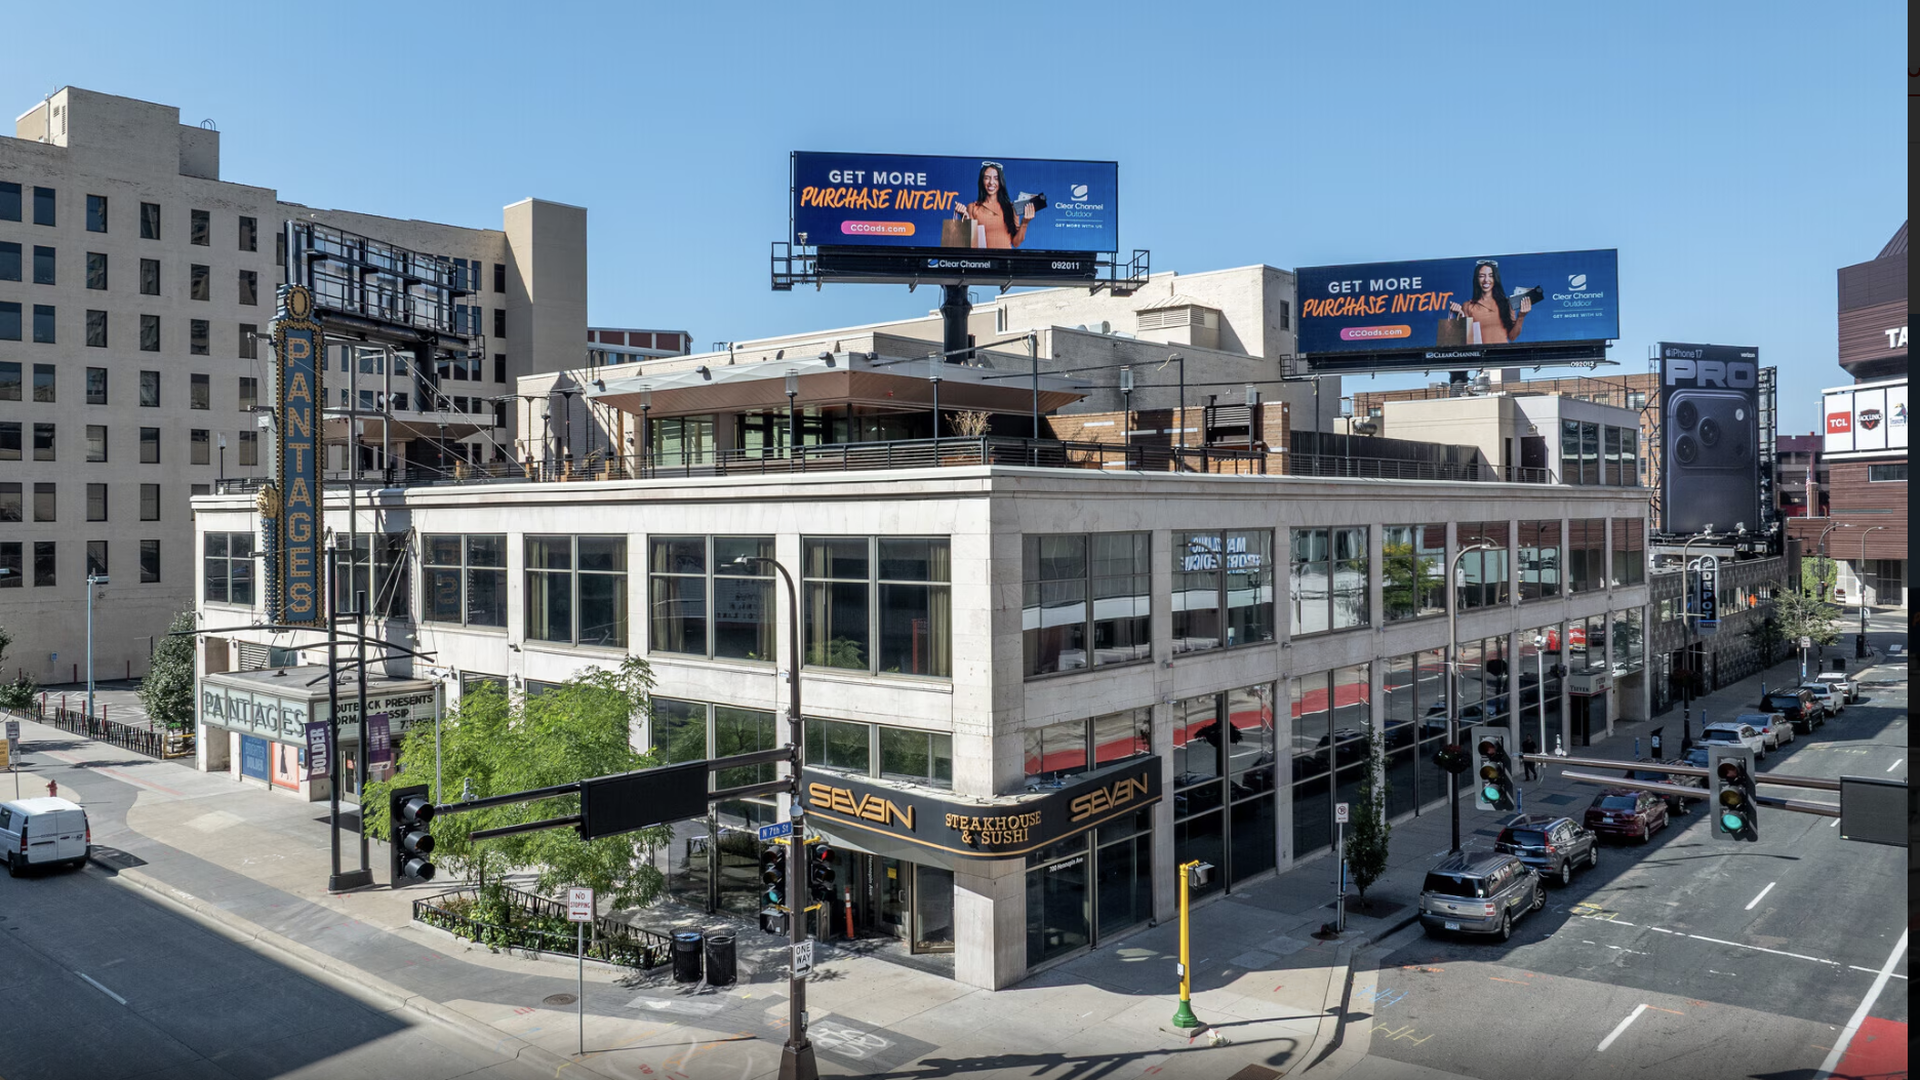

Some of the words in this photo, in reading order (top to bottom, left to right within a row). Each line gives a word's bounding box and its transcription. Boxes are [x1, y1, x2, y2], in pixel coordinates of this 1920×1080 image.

[828, 170, 866, 184] GET
[873, 171, 927, 186] MORE
[800, 186, 892, 211] PURCHASE
[894, 188, 959, 211] INTENT
[1055, 202, 1074, 210] Clear
[1074, 202, 1104, 210] Channel
[850, 224, 907, 233] CCOads.com
[939, 260, 959, 268] Clear
[960, 260, 991, 269] Channel
[1051, 261, 1080, 270] 092011
[1328, 280, 1363, 294] GET
[1369, 276, 1423, 292] MORE
[1552, 293, 1572, 301] Clear
[1573, 291, 1604, 300] Channel
[1302, 295, 1389, 318] PURCHASE
[1391, 291, 1454, 313] INTENT
[1348, 328, 1403, 338] CCOads.com
[1670, 348, 1695, 358] iPhone
[1695, 349, 1703, 358] 17
[1666, 358, 1756, 389] PRO
[1829, 418, 1848, 428] TCL
[287, 337, 312, 613] PANTAGES
[1702, 571, 1713, 619] DEPOT
[386, 694, 434, 708] PRESENTS
[204, 691, 306, 738] PANTAGES
[310, 727, 327, 776] BOLDER
[945, 810, 1041, 830] STEAKHOUSE
[762, 829, 767, 838] N
[769, 826, 780, 836] 7th
[782, 824, 789, 834] St
[961, 829, 973, 844] &
[981, 828, 1029, 845] SUSHI
[795, 943, 811, 955] ONE
[796, 953, 811, 965] WAY
